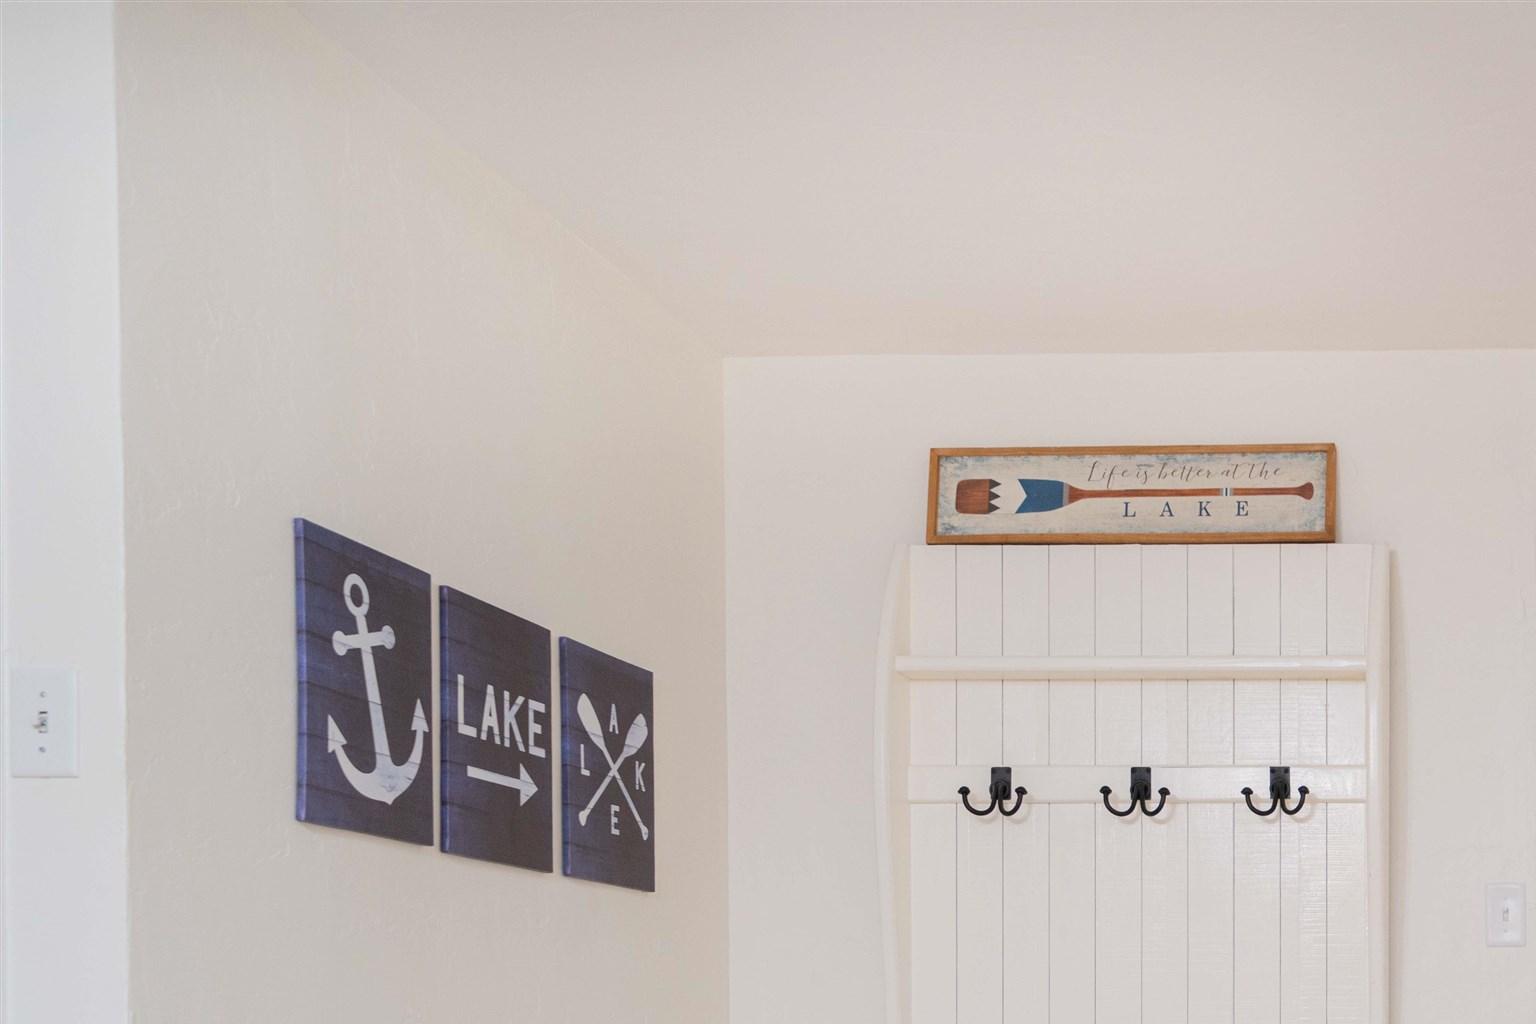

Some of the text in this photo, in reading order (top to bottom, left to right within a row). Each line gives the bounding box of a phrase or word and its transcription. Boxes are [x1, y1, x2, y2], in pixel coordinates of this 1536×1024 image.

[1088, 460, 1281, 488] Life is better at the
[1122, 500, 1249, 518] LAKE
[457, 673, 546, 758] LAKE
